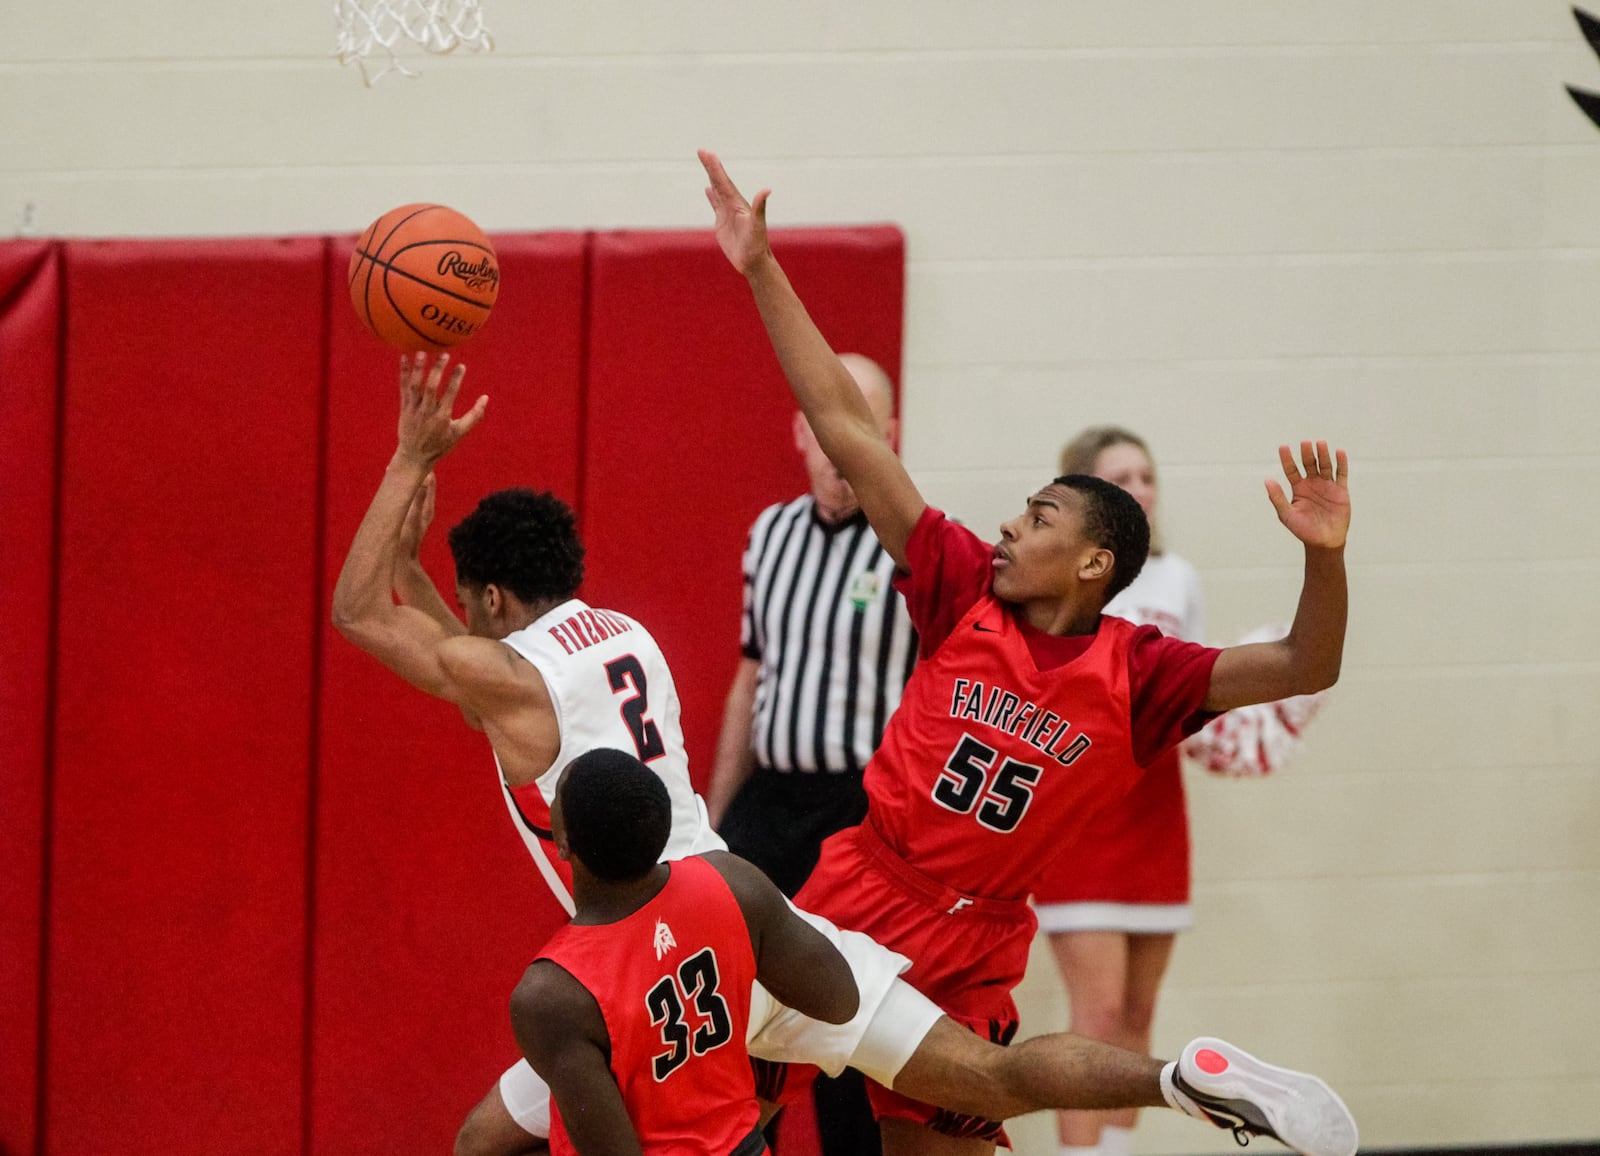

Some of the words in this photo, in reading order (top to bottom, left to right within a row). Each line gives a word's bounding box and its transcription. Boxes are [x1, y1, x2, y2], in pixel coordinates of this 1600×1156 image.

[603, 653, 667, 765] 2
[949, 678, 1092, 767] FAIRFIELD
[931, 732, 1044, 834] 55
[645, 946, 733, 1083] 33
